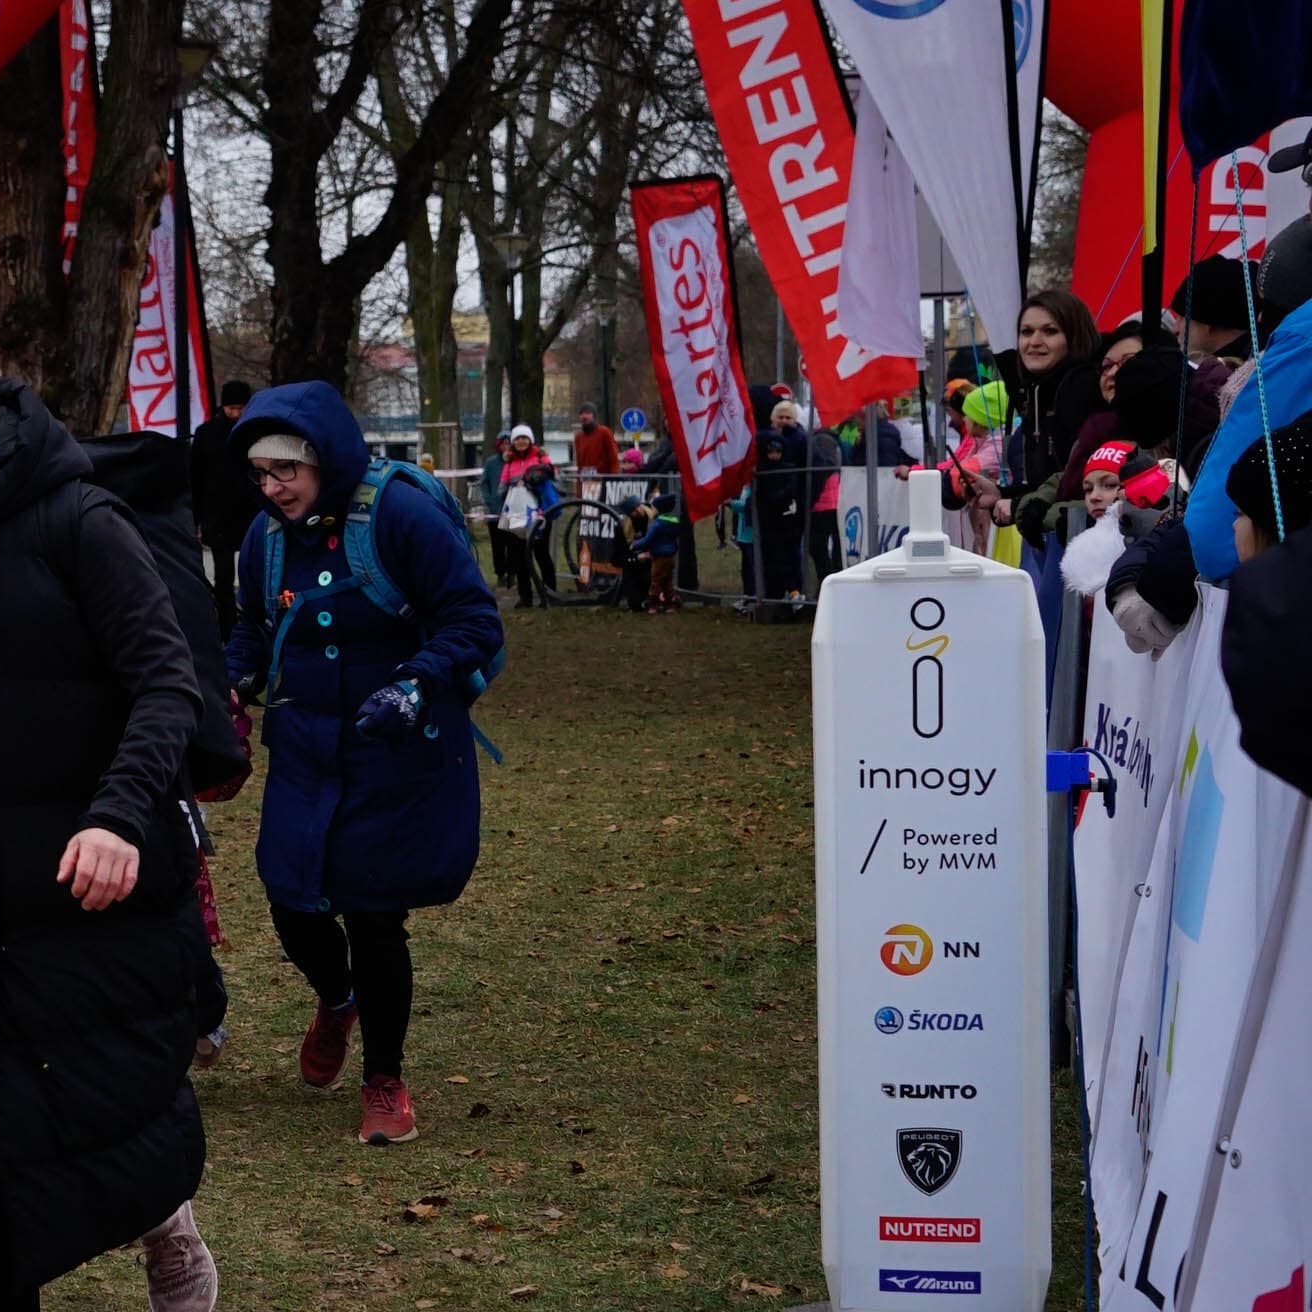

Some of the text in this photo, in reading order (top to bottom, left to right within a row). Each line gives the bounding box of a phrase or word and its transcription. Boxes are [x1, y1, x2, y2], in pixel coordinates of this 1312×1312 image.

[1087, 447, 1127, 464] ORE
[859, 759, 997, 796] innogy
[903, 828, 998, 846] Powered
[903, 852, 996, 874] by MVM
[943, 942, 980, 958] NN
[908, 1009, 984, 1031] ŠKODA
[900, 1085, 977, 1099] RUNTO
[903, 1133, 956, 1141] PEUGEOT
[885, 1222, 976, 1238] NUTREND
